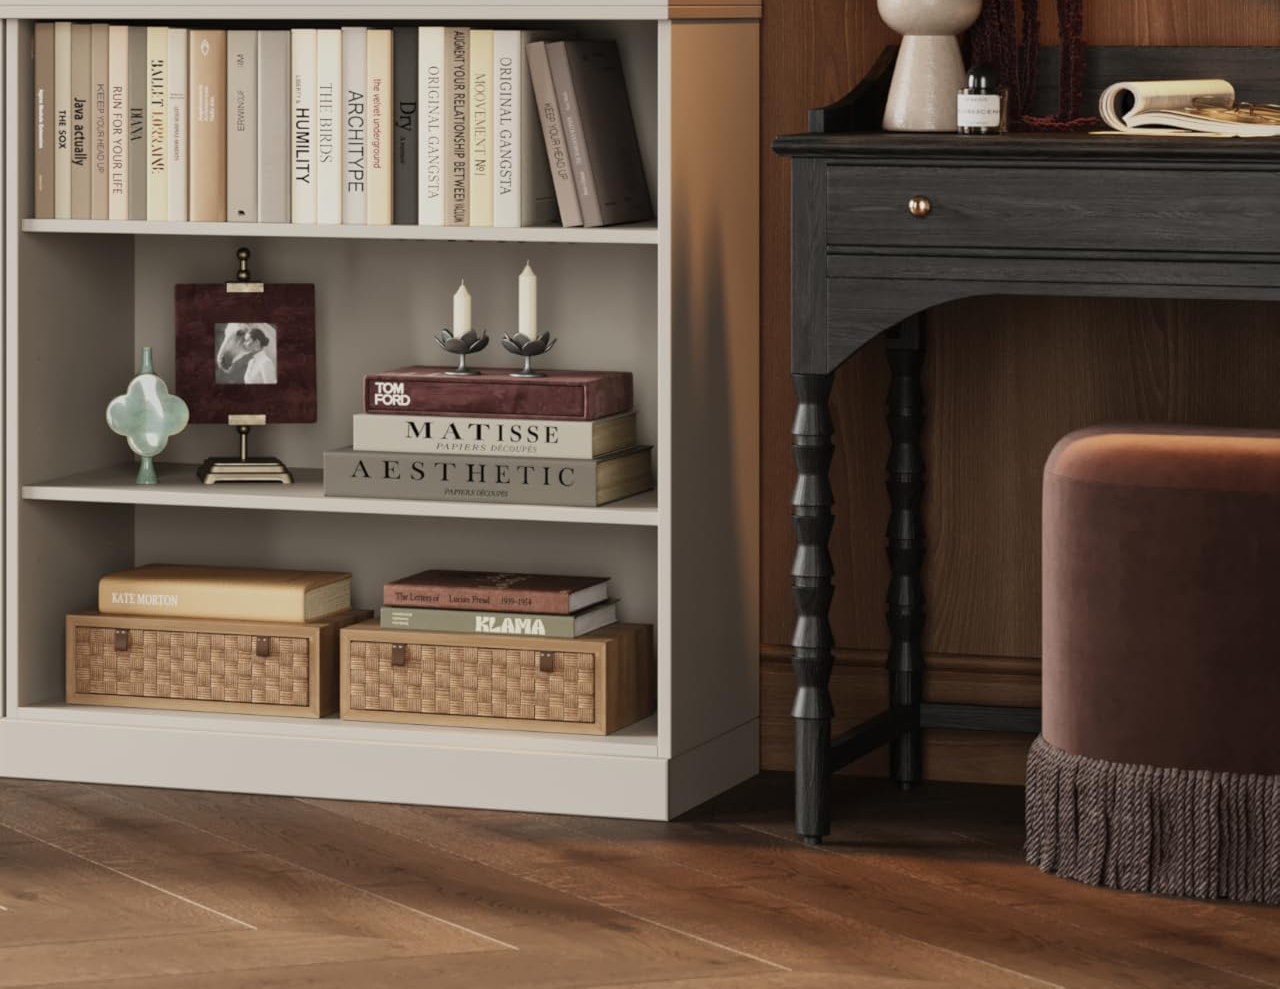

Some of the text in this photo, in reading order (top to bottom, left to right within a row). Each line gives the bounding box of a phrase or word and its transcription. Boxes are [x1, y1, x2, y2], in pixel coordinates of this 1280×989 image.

[453, 31, 465, 63] AUGMENT
[453, 65, 465, 90] YOUR
[72, 97, 87, 166] Java actually
[97, 83, 105, 174] KEEP YOUR HEAD UP
[130, 107, 143, 141] DIANA
[319, 82, 333, 163] THE BIRDS
[372, 78, 382, 169] the velvet underground
[395, 101, 416, 131] Dry
[427, 66, 439, 199] ORIGINAL GANGSTA
[453, 93, 465, 159] RELATIONSHIP
[474, 73, 486, 155] MOOVEMENT
[498, 58, 512, 195] ORIGINAL GANGSTA
[112, 86, 122, 195] RUN FOR YOUR LIFE
[296, 107, 310, 184] HUMILITY
[348, 90, 364, 193] ARCHITYPE
[543, 102, 568, 180] KEEP YOUR HEAD UP
[453, 161, 465, 203] BETWEEN
[374, 394, 411, 407] FORD
[375, 382, 404, 394] TOM
[405, 421, 559, 444] MATISSE
[436, 442, 487, 452] PAPIERS
[351, 459, 575, 487] AESTHETIC
[112, 593, 178, 606] KATE MORTON
[395, 591, 409, 601] The
[449, 594, 470, 603] Lucian
[472, 595, 490, 604] Freud
[475, 615, 546, 636] KLAMA
